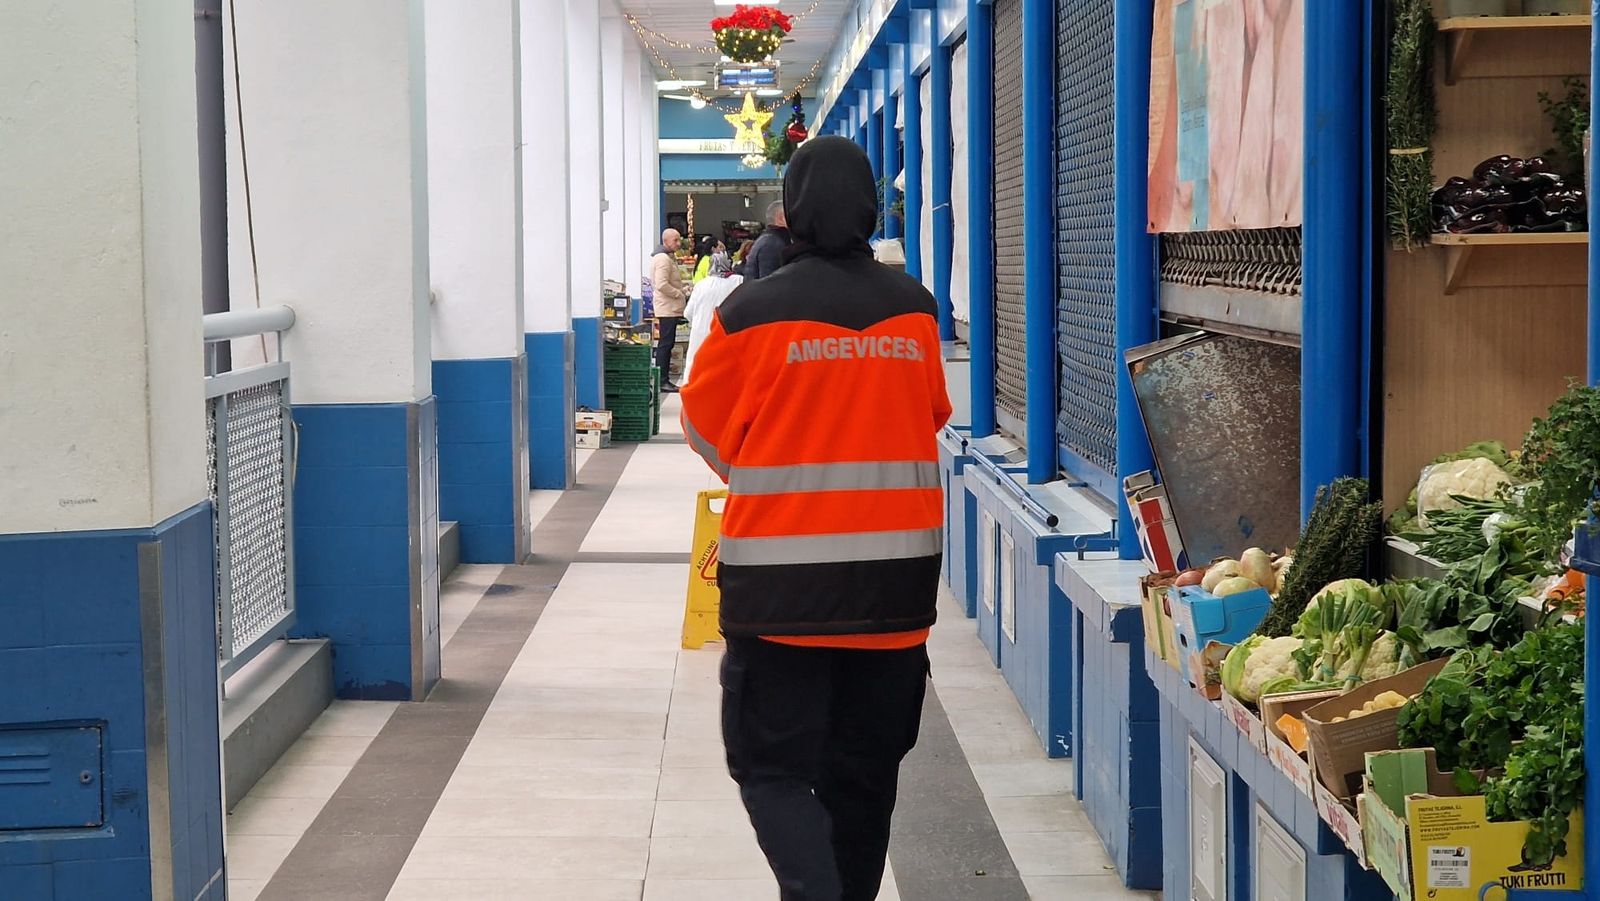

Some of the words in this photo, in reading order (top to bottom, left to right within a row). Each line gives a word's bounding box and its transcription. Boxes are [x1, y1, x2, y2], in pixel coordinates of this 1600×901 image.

[697, 539, 717, 570] ACHTUNG
[1499, 875, 1525, 889] TUKI
[1527, 873, 1566, 888] FRUTTI
